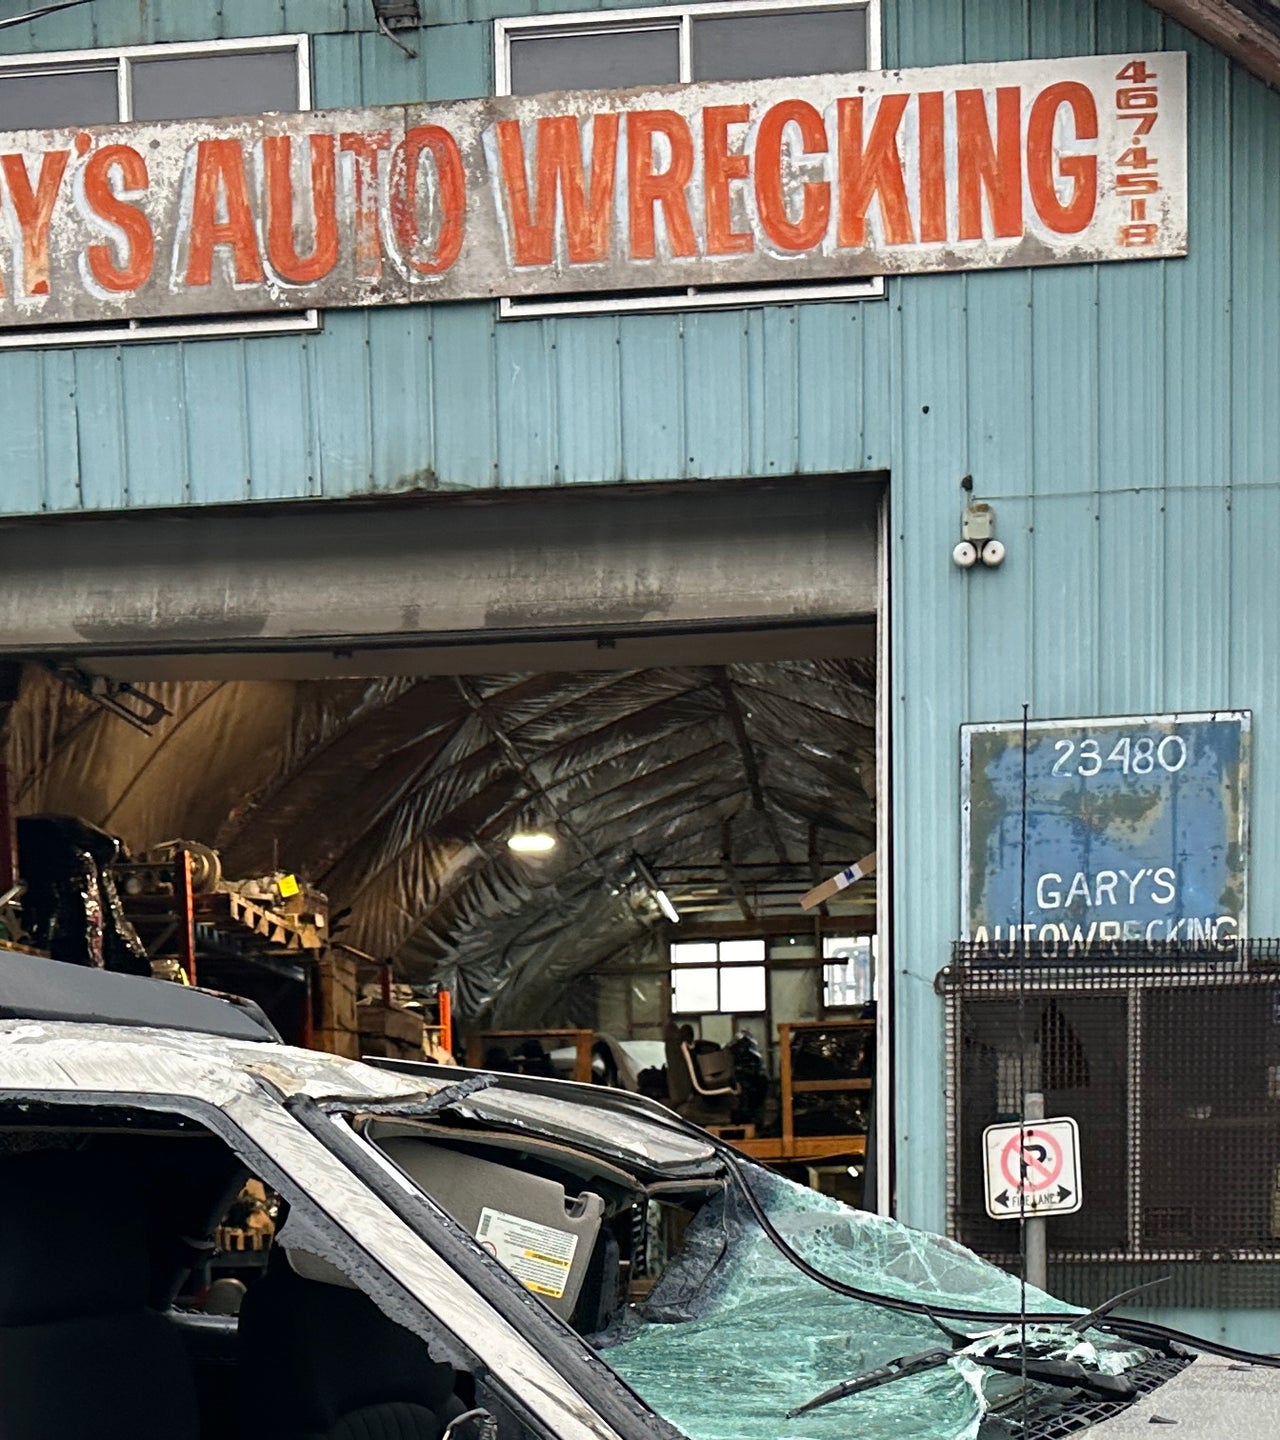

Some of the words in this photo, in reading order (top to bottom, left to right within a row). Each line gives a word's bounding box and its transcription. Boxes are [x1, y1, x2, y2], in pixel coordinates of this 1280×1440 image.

[185, 124, 466, 285] AUTO
[495, 81, 1100, 268] WRECKING
[1051, 735, 1187, 777] 23480
[1036, 867, 1176, 909] GARY'S
